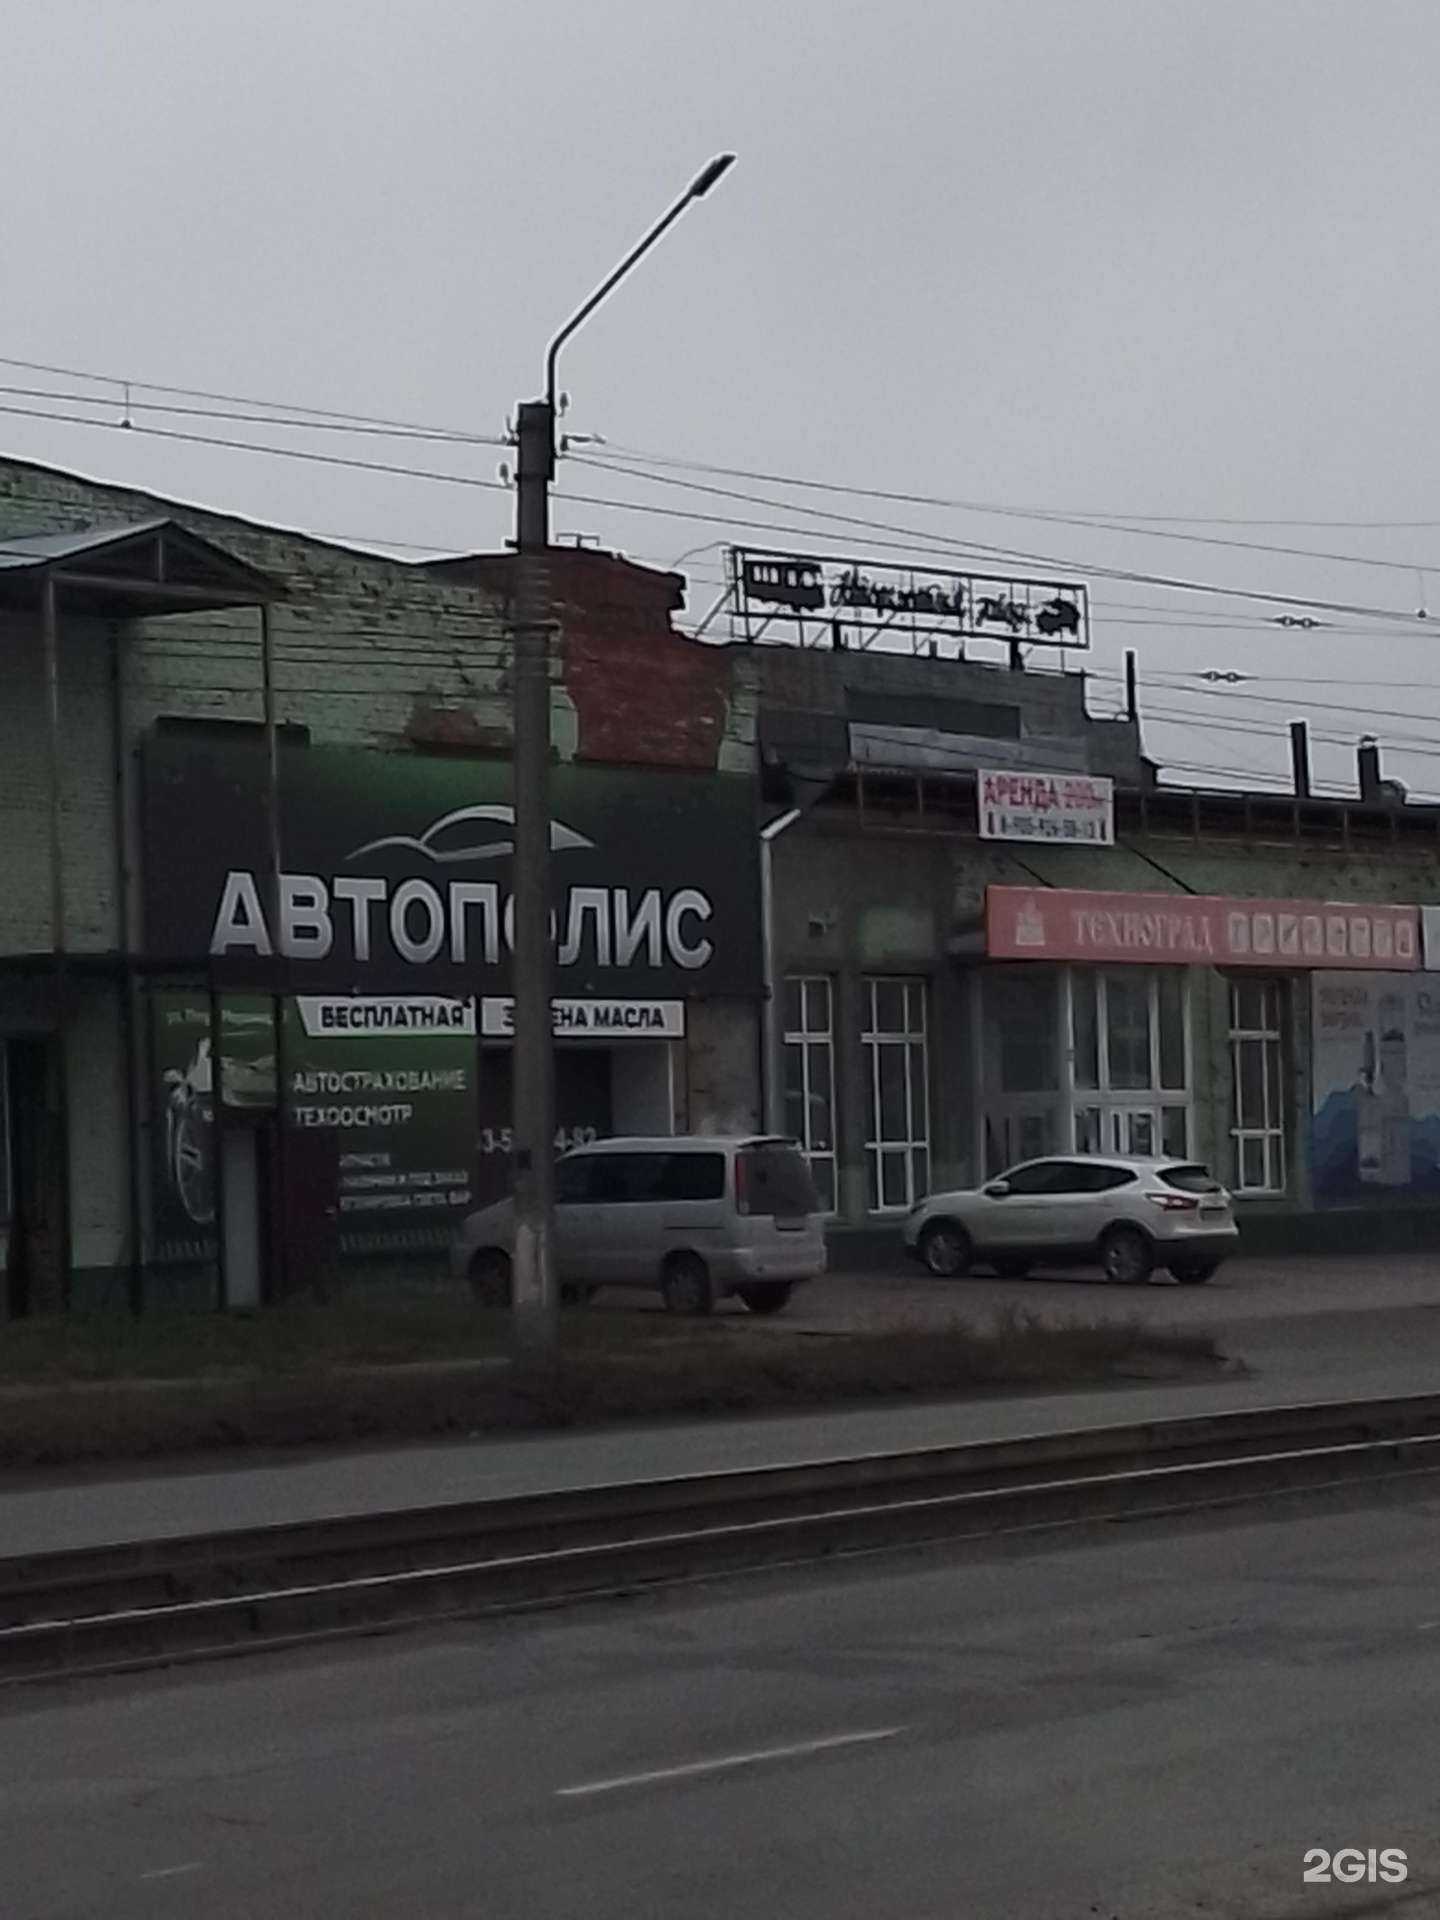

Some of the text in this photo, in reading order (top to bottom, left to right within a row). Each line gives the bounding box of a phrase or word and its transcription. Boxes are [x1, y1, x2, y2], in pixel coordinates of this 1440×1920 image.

[984, 775, 1060, 811] АРЕНДА
[209, 870, 713, 970] АВТОПЛИС
[321, 1004, 465, 1029] БЕСПЛАТНАЯ
[593, 1006, 665, 1029] МАСЛА
